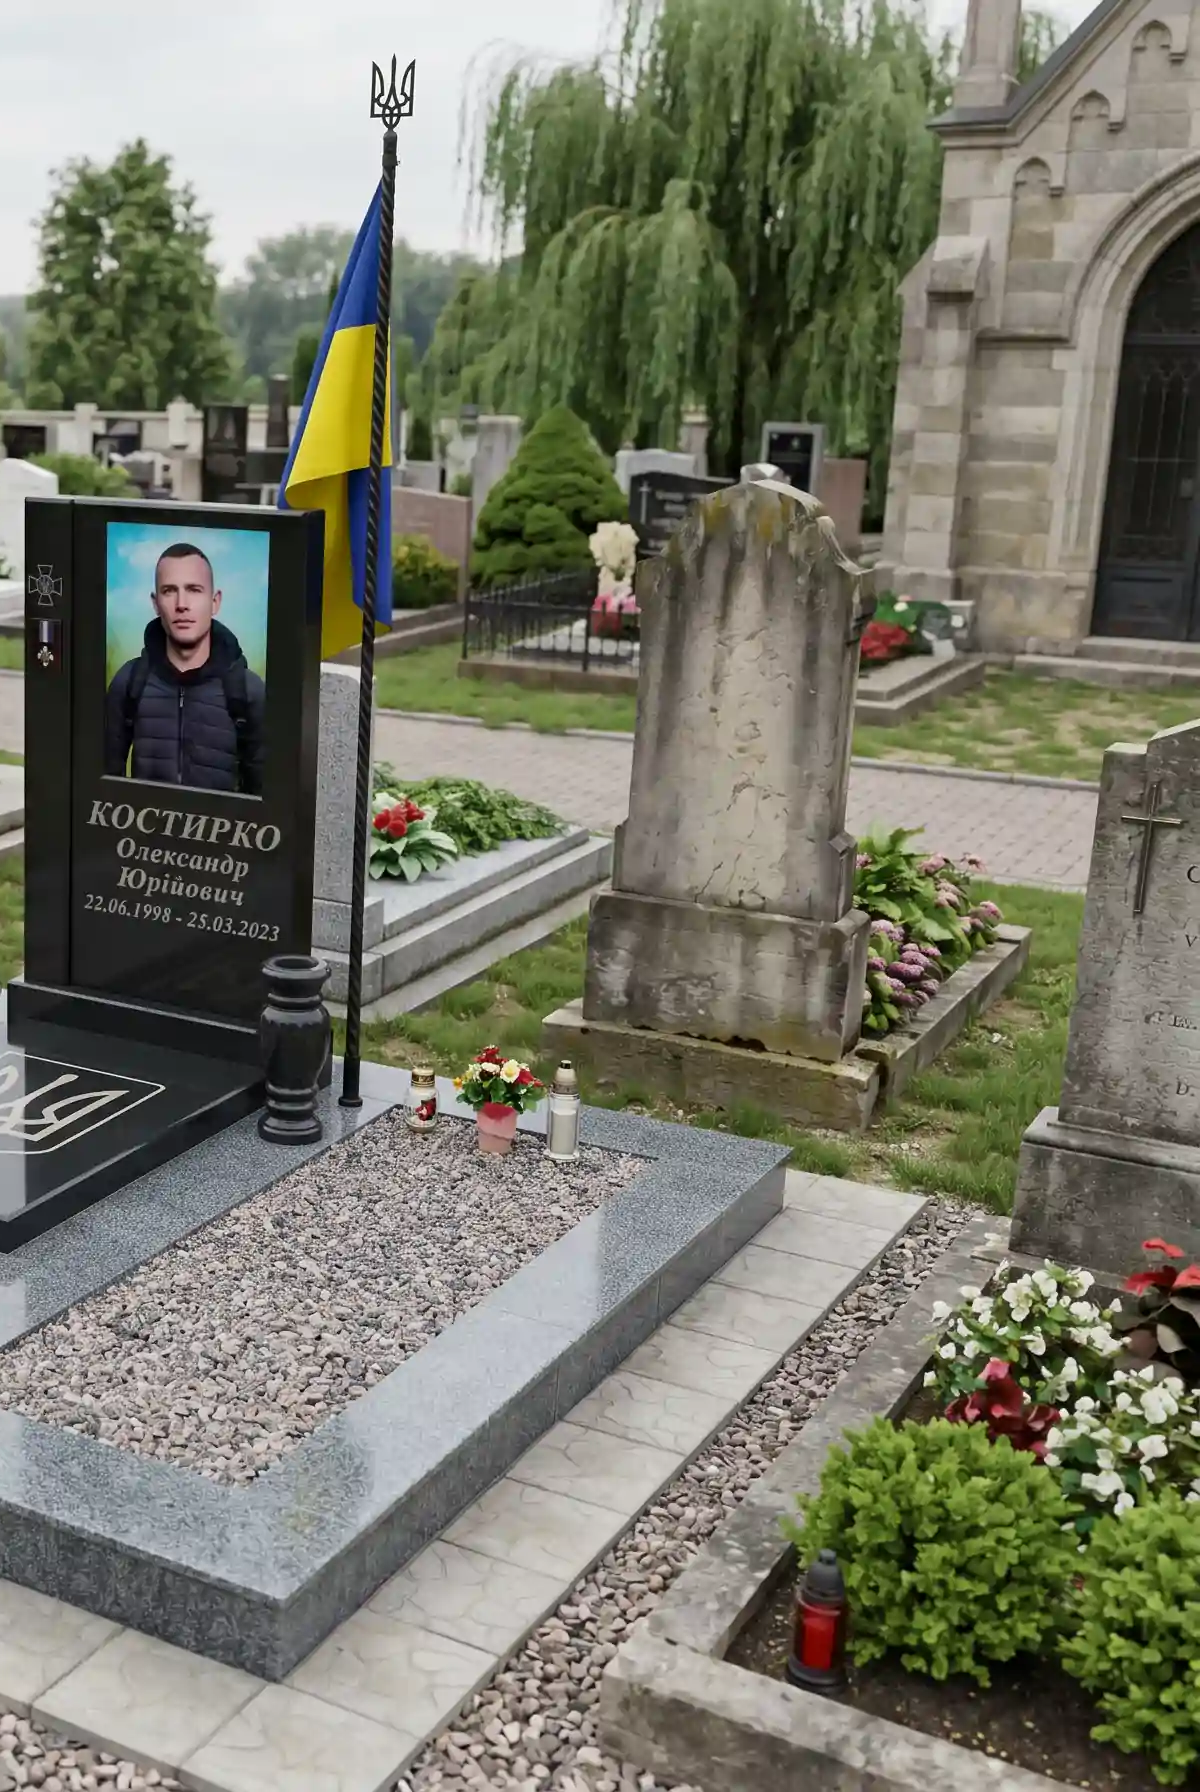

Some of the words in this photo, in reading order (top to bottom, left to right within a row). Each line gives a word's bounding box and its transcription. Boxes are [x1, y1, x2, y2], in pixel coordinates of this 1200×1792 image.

[86, 800, 281, 851] КОСТИРКО
[116, 837, 249, 882] Олександр
[116, 866, 244, 906] Юрійович
[84, 894, 171, 923] 22.06.1998
[186, 912, 280, 942] 25.03.2023
